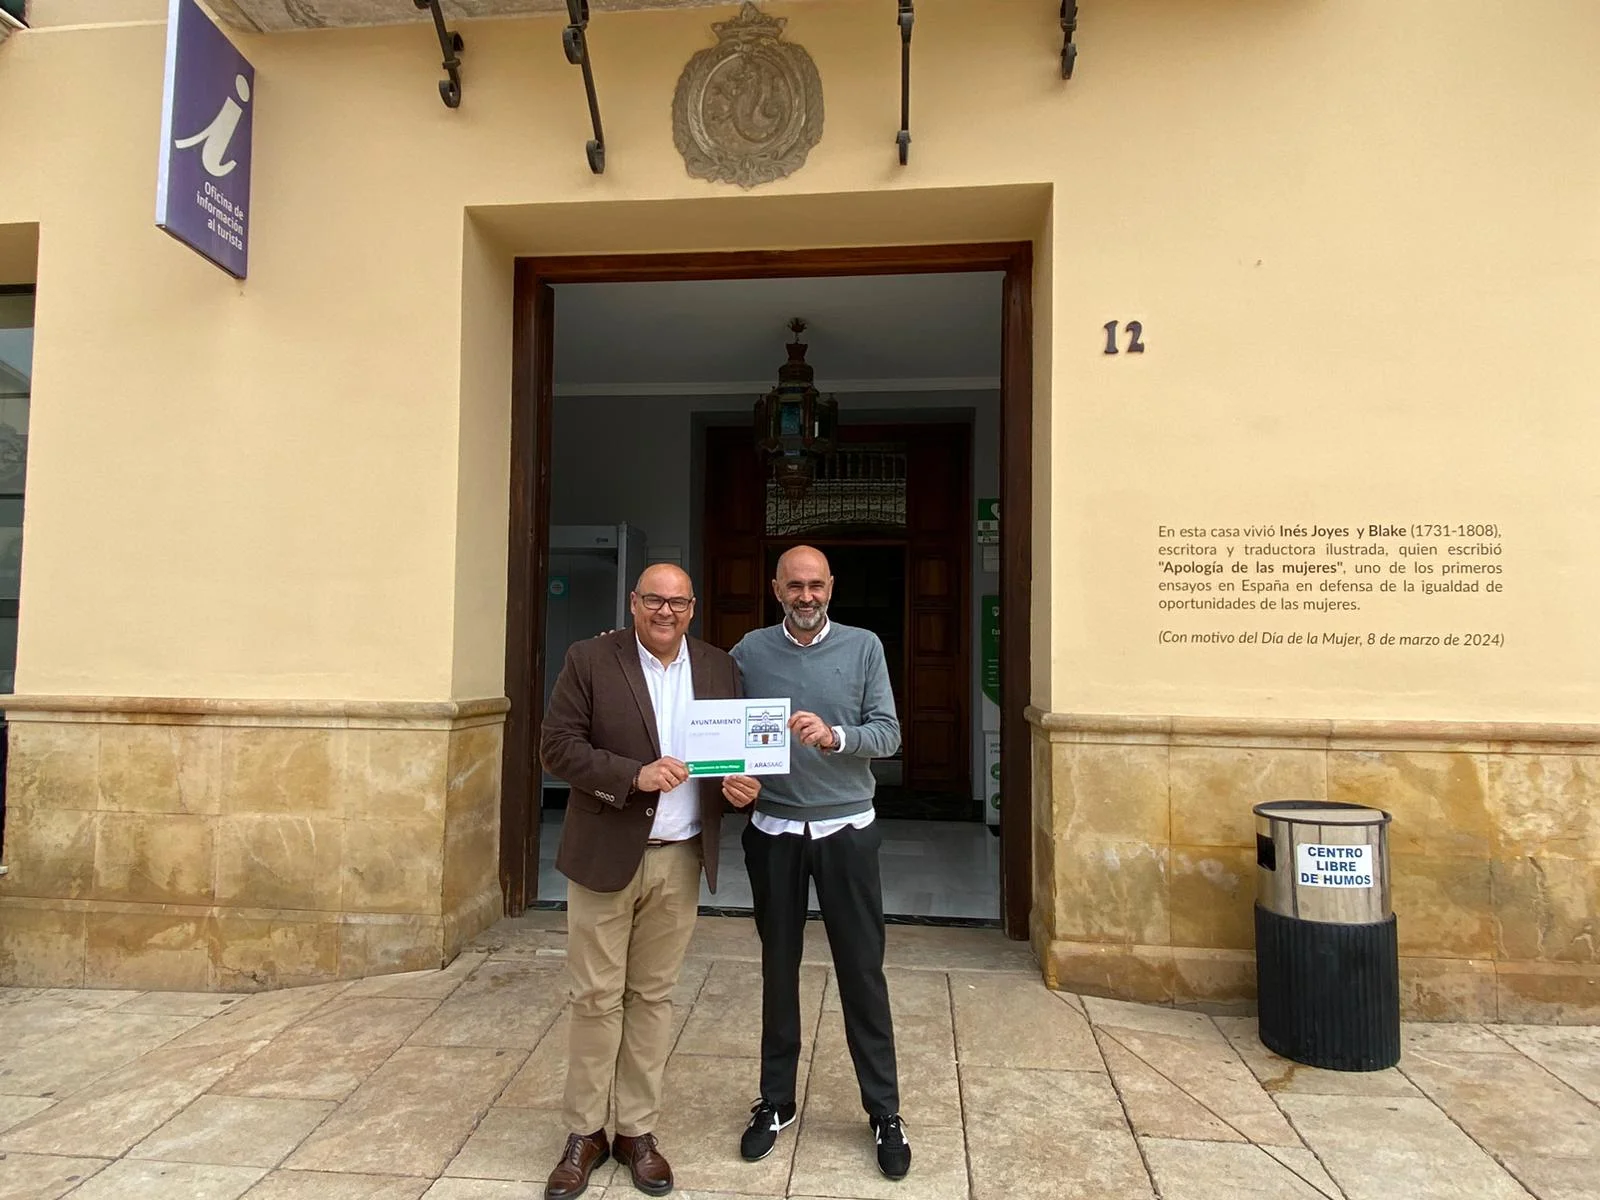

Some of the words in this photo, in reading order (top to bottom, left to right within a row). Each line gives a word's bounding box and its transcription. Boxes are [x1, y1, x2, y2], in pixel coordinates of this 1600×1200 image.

[205, 182, 233, 212] Oficina
[234, 204, 244, 221] de
[196, 190, 244, 236] información
[207, 218, 216, 232] al
[217, 222, 243, 251] turista
[1103, 319, 1145, 354] 12
[1159, 526, 1175, 537] En
[1180, 527, 1206, 537] esta
[1211, 528, 1240, 537] casa
[1243, 525, 1275, 537] vivió
[1280, 524, 1307, 537] Inés
[1311, 525, 1349, 539] Joyes
[1357, 528, 1365, 539] y
[1369, 524, 1406, 537] Blake
[1411, 524, 1501, 538] (1731-1808),
[1159, 543, 1216, 555] escritora
[1226, 547, 1234, 557] y
[1244, 543, 1315, 555] traductora
[1326, 543, 1388, 556] ilustrada,
[1399, 543, 1437, 558] quien
[1448, 543, 1502, 555] escribió
[1159, 561, 1223, 576] "Apología
[1231, 561, 1248, 573] de
[1256, 561, 1274, 573] las
[1282, 561, 1346, 576] mujeres",
[1355, 564, 1381, 574] uno
[1389, 562, 1406, 574] de
[1415, 561, 1433, 574] los
[1442, 562, 1502, 576] primeros
[1159, 582, 1212, 594] ensayos
[1218, 583, 1234, 591] en
[1242, 579, 1289, 594] España
[1296, 583, 1312, 592] en
[1320, 579, 1373, 592] defensa
[1380, 580, 1396, 592] de
[1404, 580, 1414, 592] la
[1421, 580, 1479, 594] igualdad
[1486, 580, 1503, 592] de
[1159, 597, 1256, 611] oportunidades
[1260, 598, 1276, 610] de
[1281, 598, 1298, 610] las
[1303, 598, 1360, 613] mujeres.
[1159, 631, 1187, 644] (Con
[1191, 632, 1235, 643] motivo
[1239, 632, 1258, 643] del
[1262, 632, 1283, 644] Día
[1288, 632, 1303, 644] de
[1307, 632, 1318, 644] la
[1322, 633, 1362, 647] Mujer,
[1367, 633, 1375, 645] 8
[1380, 633, 1395, 645] de
[1400, 637, 1440, 645] marzo
[1444, 634, 1459, 646] de
[1464, 633, 1504, 648] 2024)
[690, 718, 742, 726] AYUNTAMIENTO
[1307, 846, 1363, 858] CENTRO
[1316, 861, 1357, 872] LIBRE
[1301, 872, 1319, 884] DE
[1323, 875, 1371, 885] HUMOS
